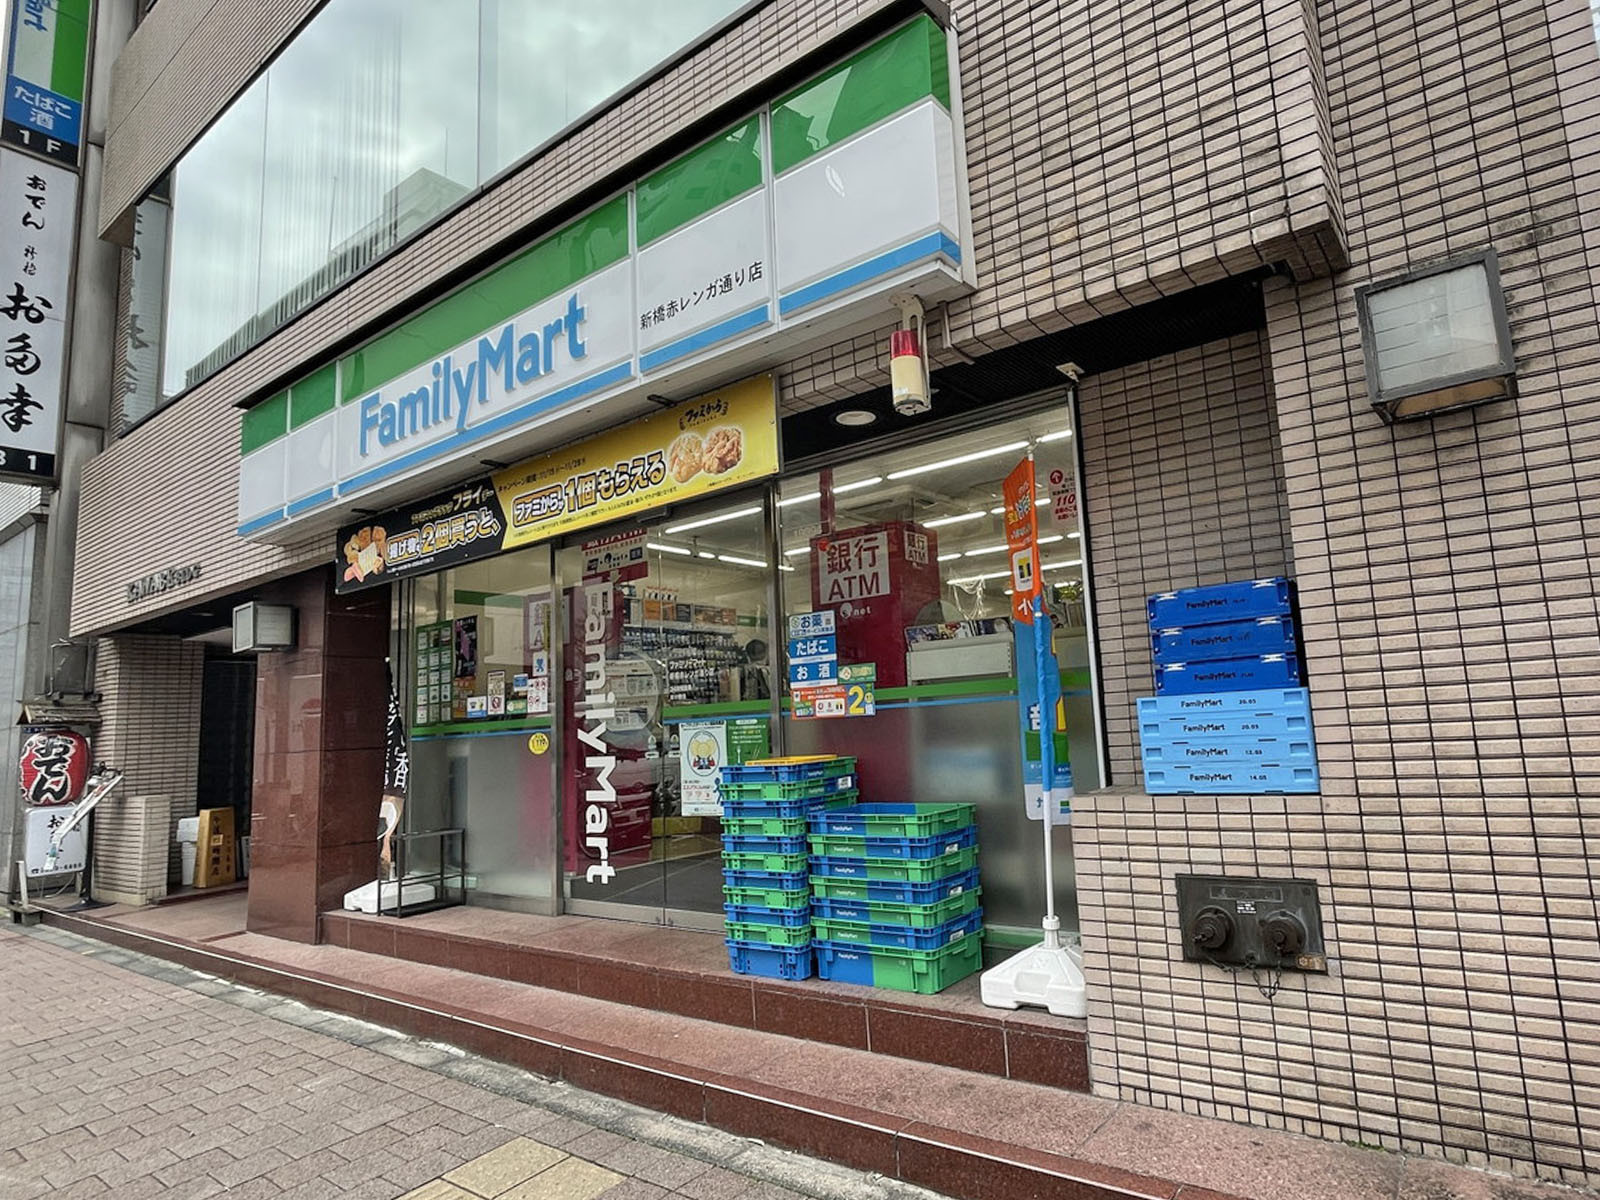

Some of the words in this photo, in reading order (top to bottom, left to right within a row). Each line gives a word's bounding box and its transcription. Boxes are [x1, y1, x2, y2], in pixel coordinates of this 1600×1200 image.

[14, 85, 72, 120] たばこ
[30, 107, 55, 130] 酒
[22, 174, 47, 230] おでん
[640, 261, 763, 330] 新橋赤レンガ通り店
[360, 291, 588, 458] FamilyMart
[827, 537, 880, 575] 銀行
[829, 572, 880, 601] ATM
[1186, 598, 1228, 609] FamilyMart
[796, 639, 829, 656] たばこ
[796, 663, 830, 680] お酒
[1181, 698, 1223, 708] FamilyMart
[1183, 723, 1225, 733] FamilyMart
[1186, 748, 1228, 757] FamilyMart
[31, 735, 76, 802] おでん
[1189, 773, 1232, 782] FamilyMart
